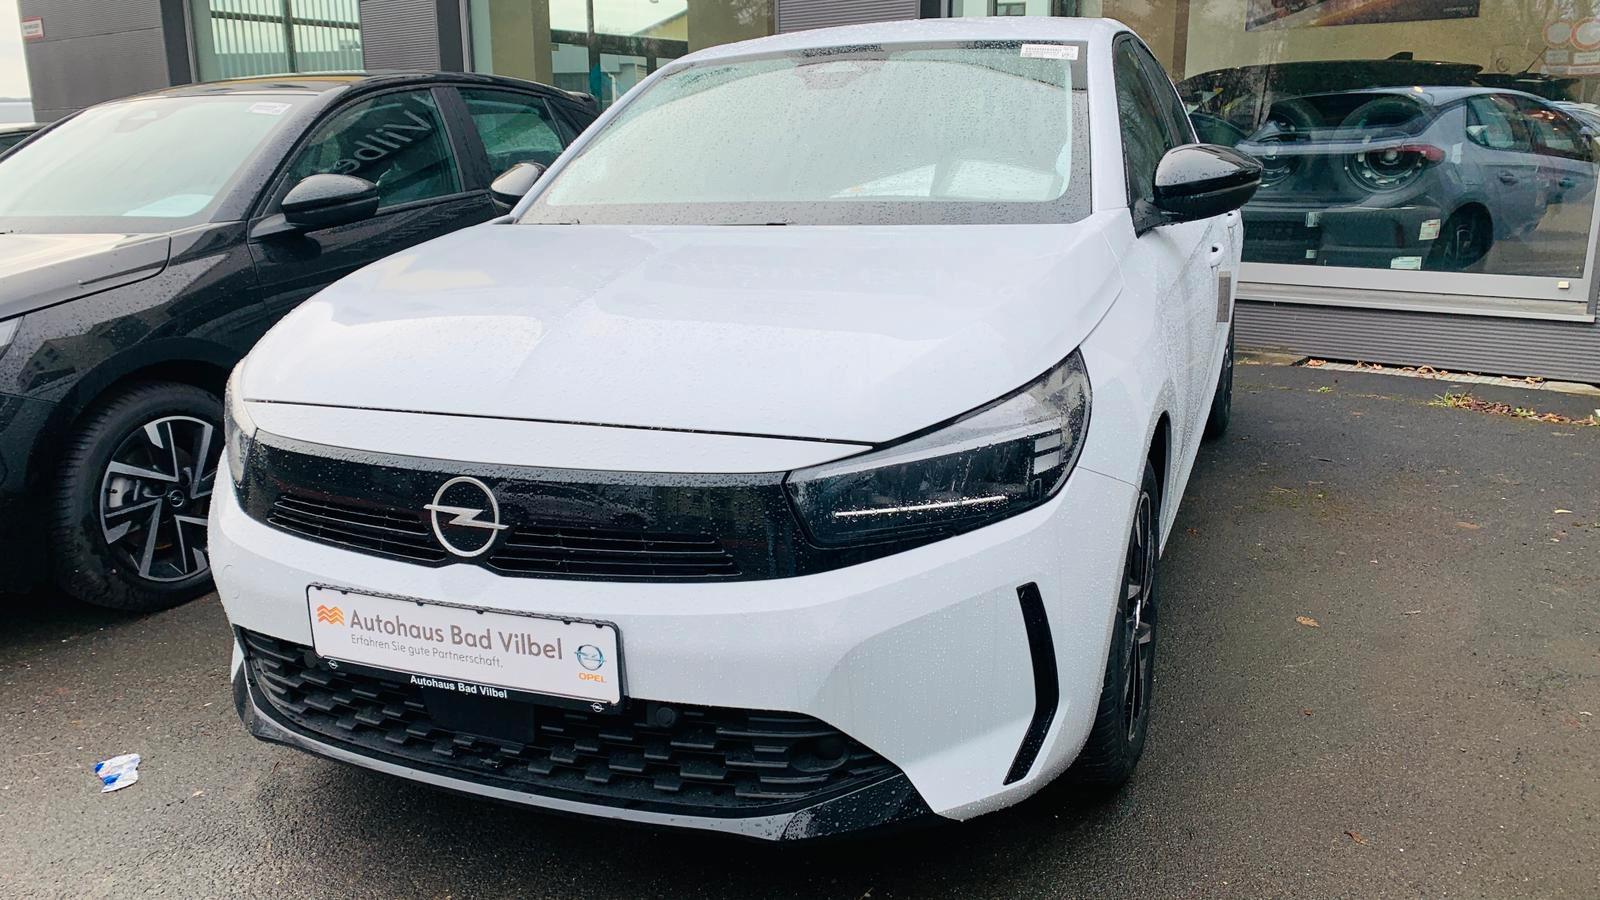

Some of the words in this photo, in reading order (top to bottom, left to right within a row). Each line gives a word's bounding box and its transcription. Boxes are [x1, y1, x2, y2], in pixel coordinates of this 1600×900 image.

[350, 609, 445, 642] Autohaus
[450, 624, 492, 650] Bad
[498, 631, 563, 660] Vilbel
[351, 633, 390, 649] Erfahren
[391, 640, 406, 653] Sie
[408, 645, 430, 657] gute
[432, 648, 504, 669] Partnerschaft.
[410, 675, 456, 690] Autohaus
[457, 682, 478, 694] Bad
[479, 686, 508, 699] Vilbel
[578, 672, 607, 684] OPEL
